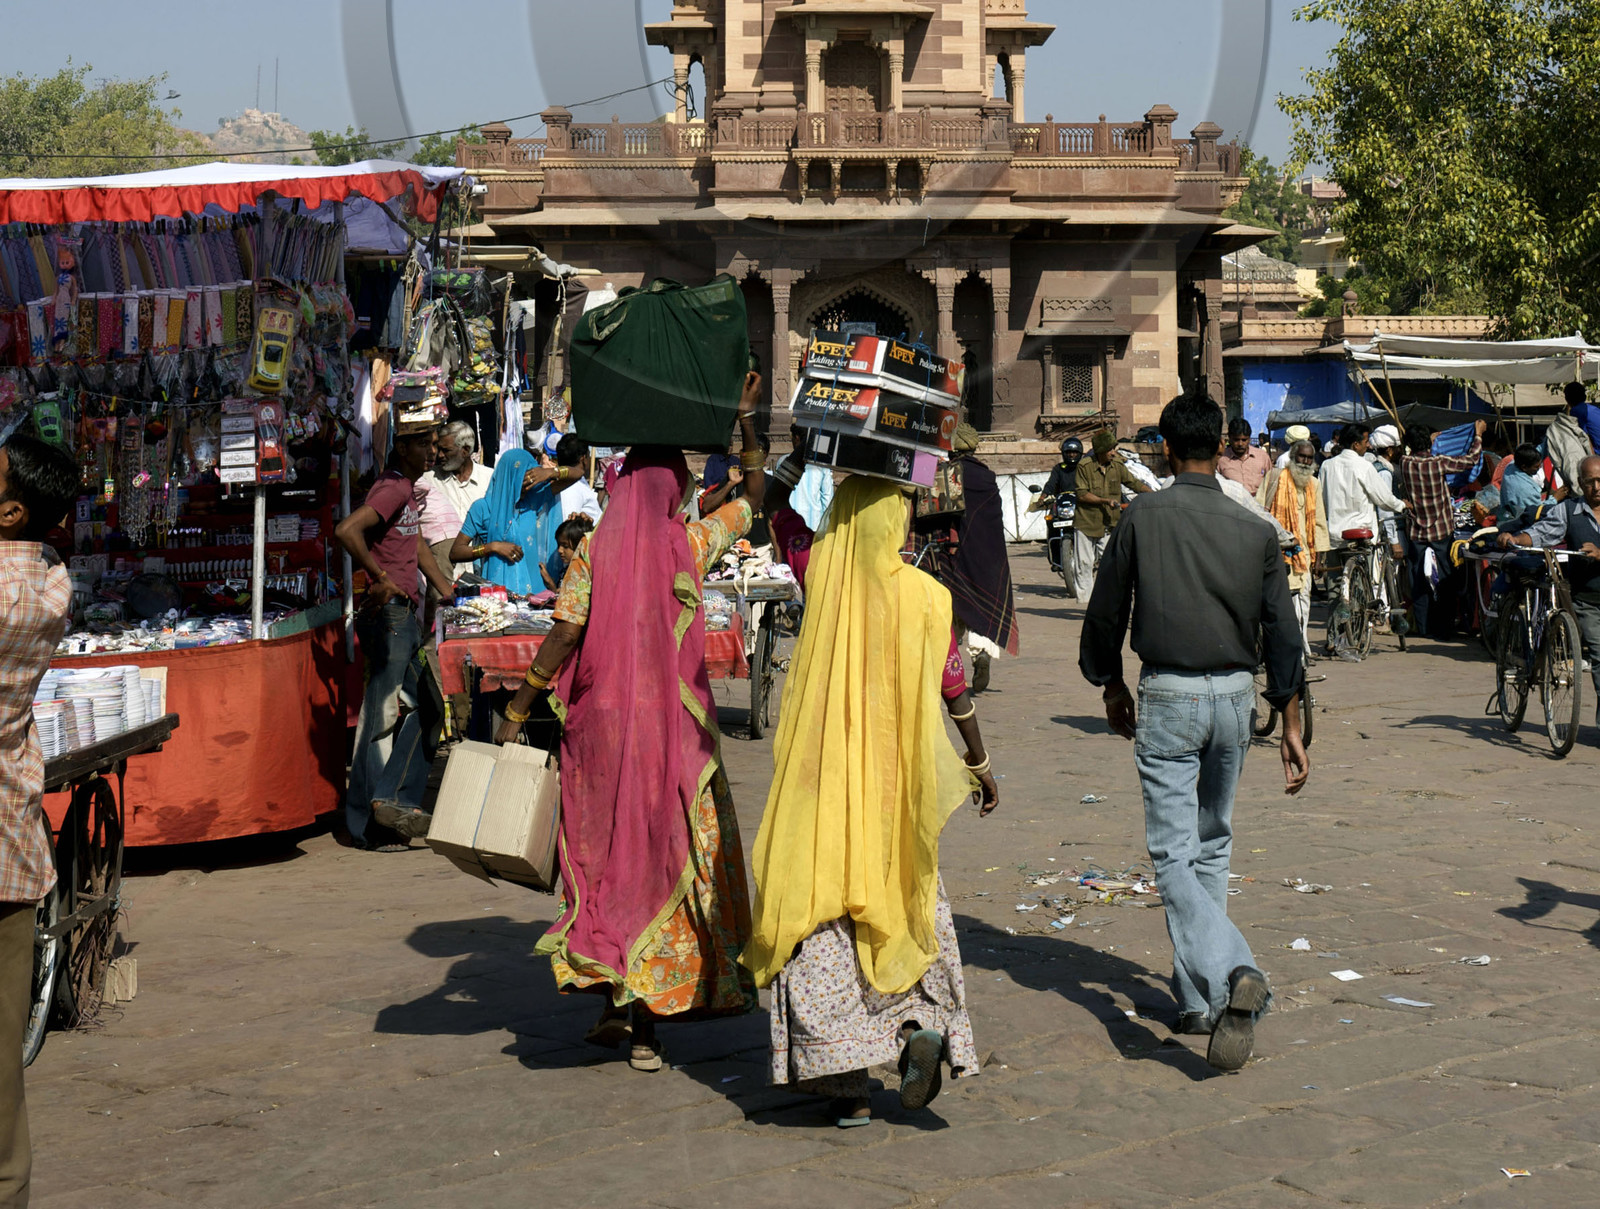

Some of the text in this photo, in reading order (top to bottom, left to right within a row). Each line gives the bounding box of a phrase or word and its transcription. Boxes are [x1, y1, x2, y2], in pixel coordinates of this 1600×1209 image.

[888, 340, 916, 365] APEX
[805, 382, 859, 403] APEX
[880, 406, 908, 430] APEX
